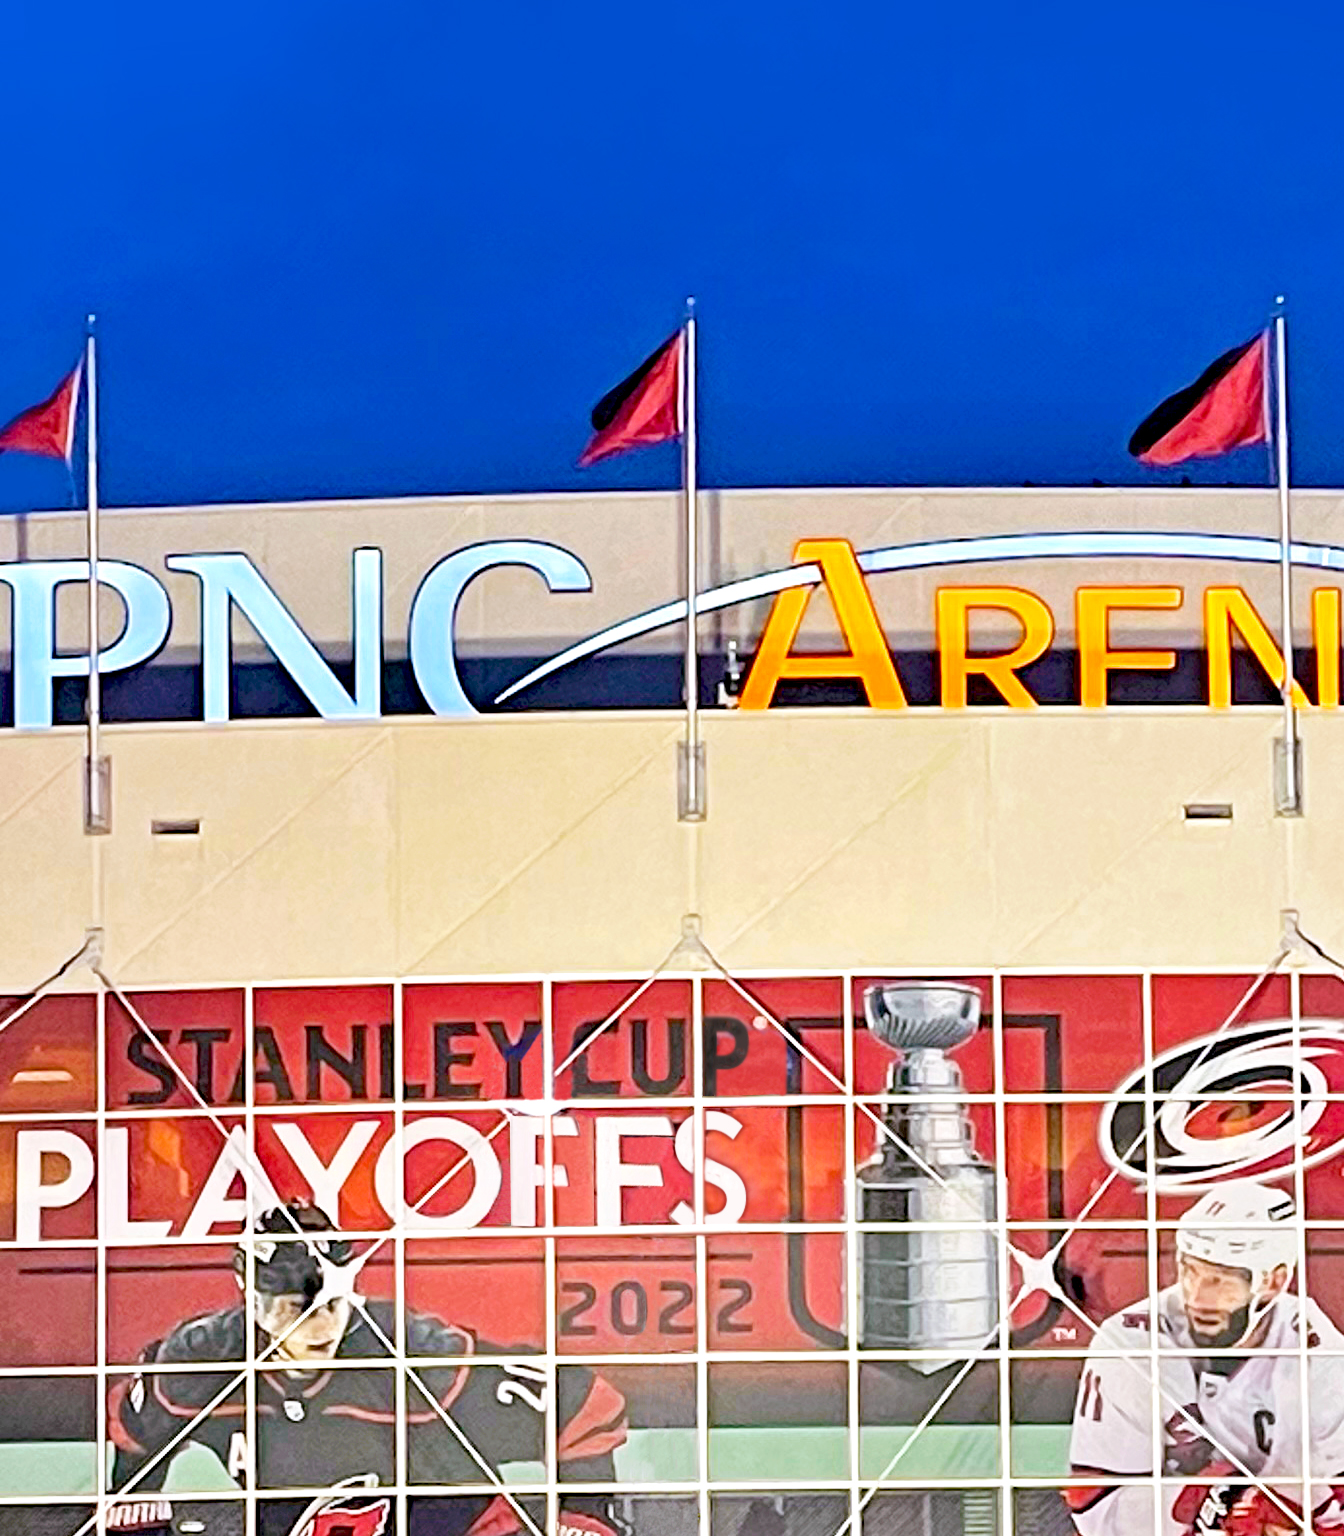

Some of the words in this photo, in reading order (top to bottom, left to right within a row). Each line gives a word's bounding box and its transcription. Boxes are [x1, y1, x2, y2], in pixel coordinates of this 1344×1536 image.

[126, 1018, 544, 1105] STANLEY
[570, 1015, 750, 1098] CUP
[15, 1108, 748, 1242] PLAYOFFS
[559, 1277, 754, 1337] 2022
[1253, 1408, 1276, 1456] C
